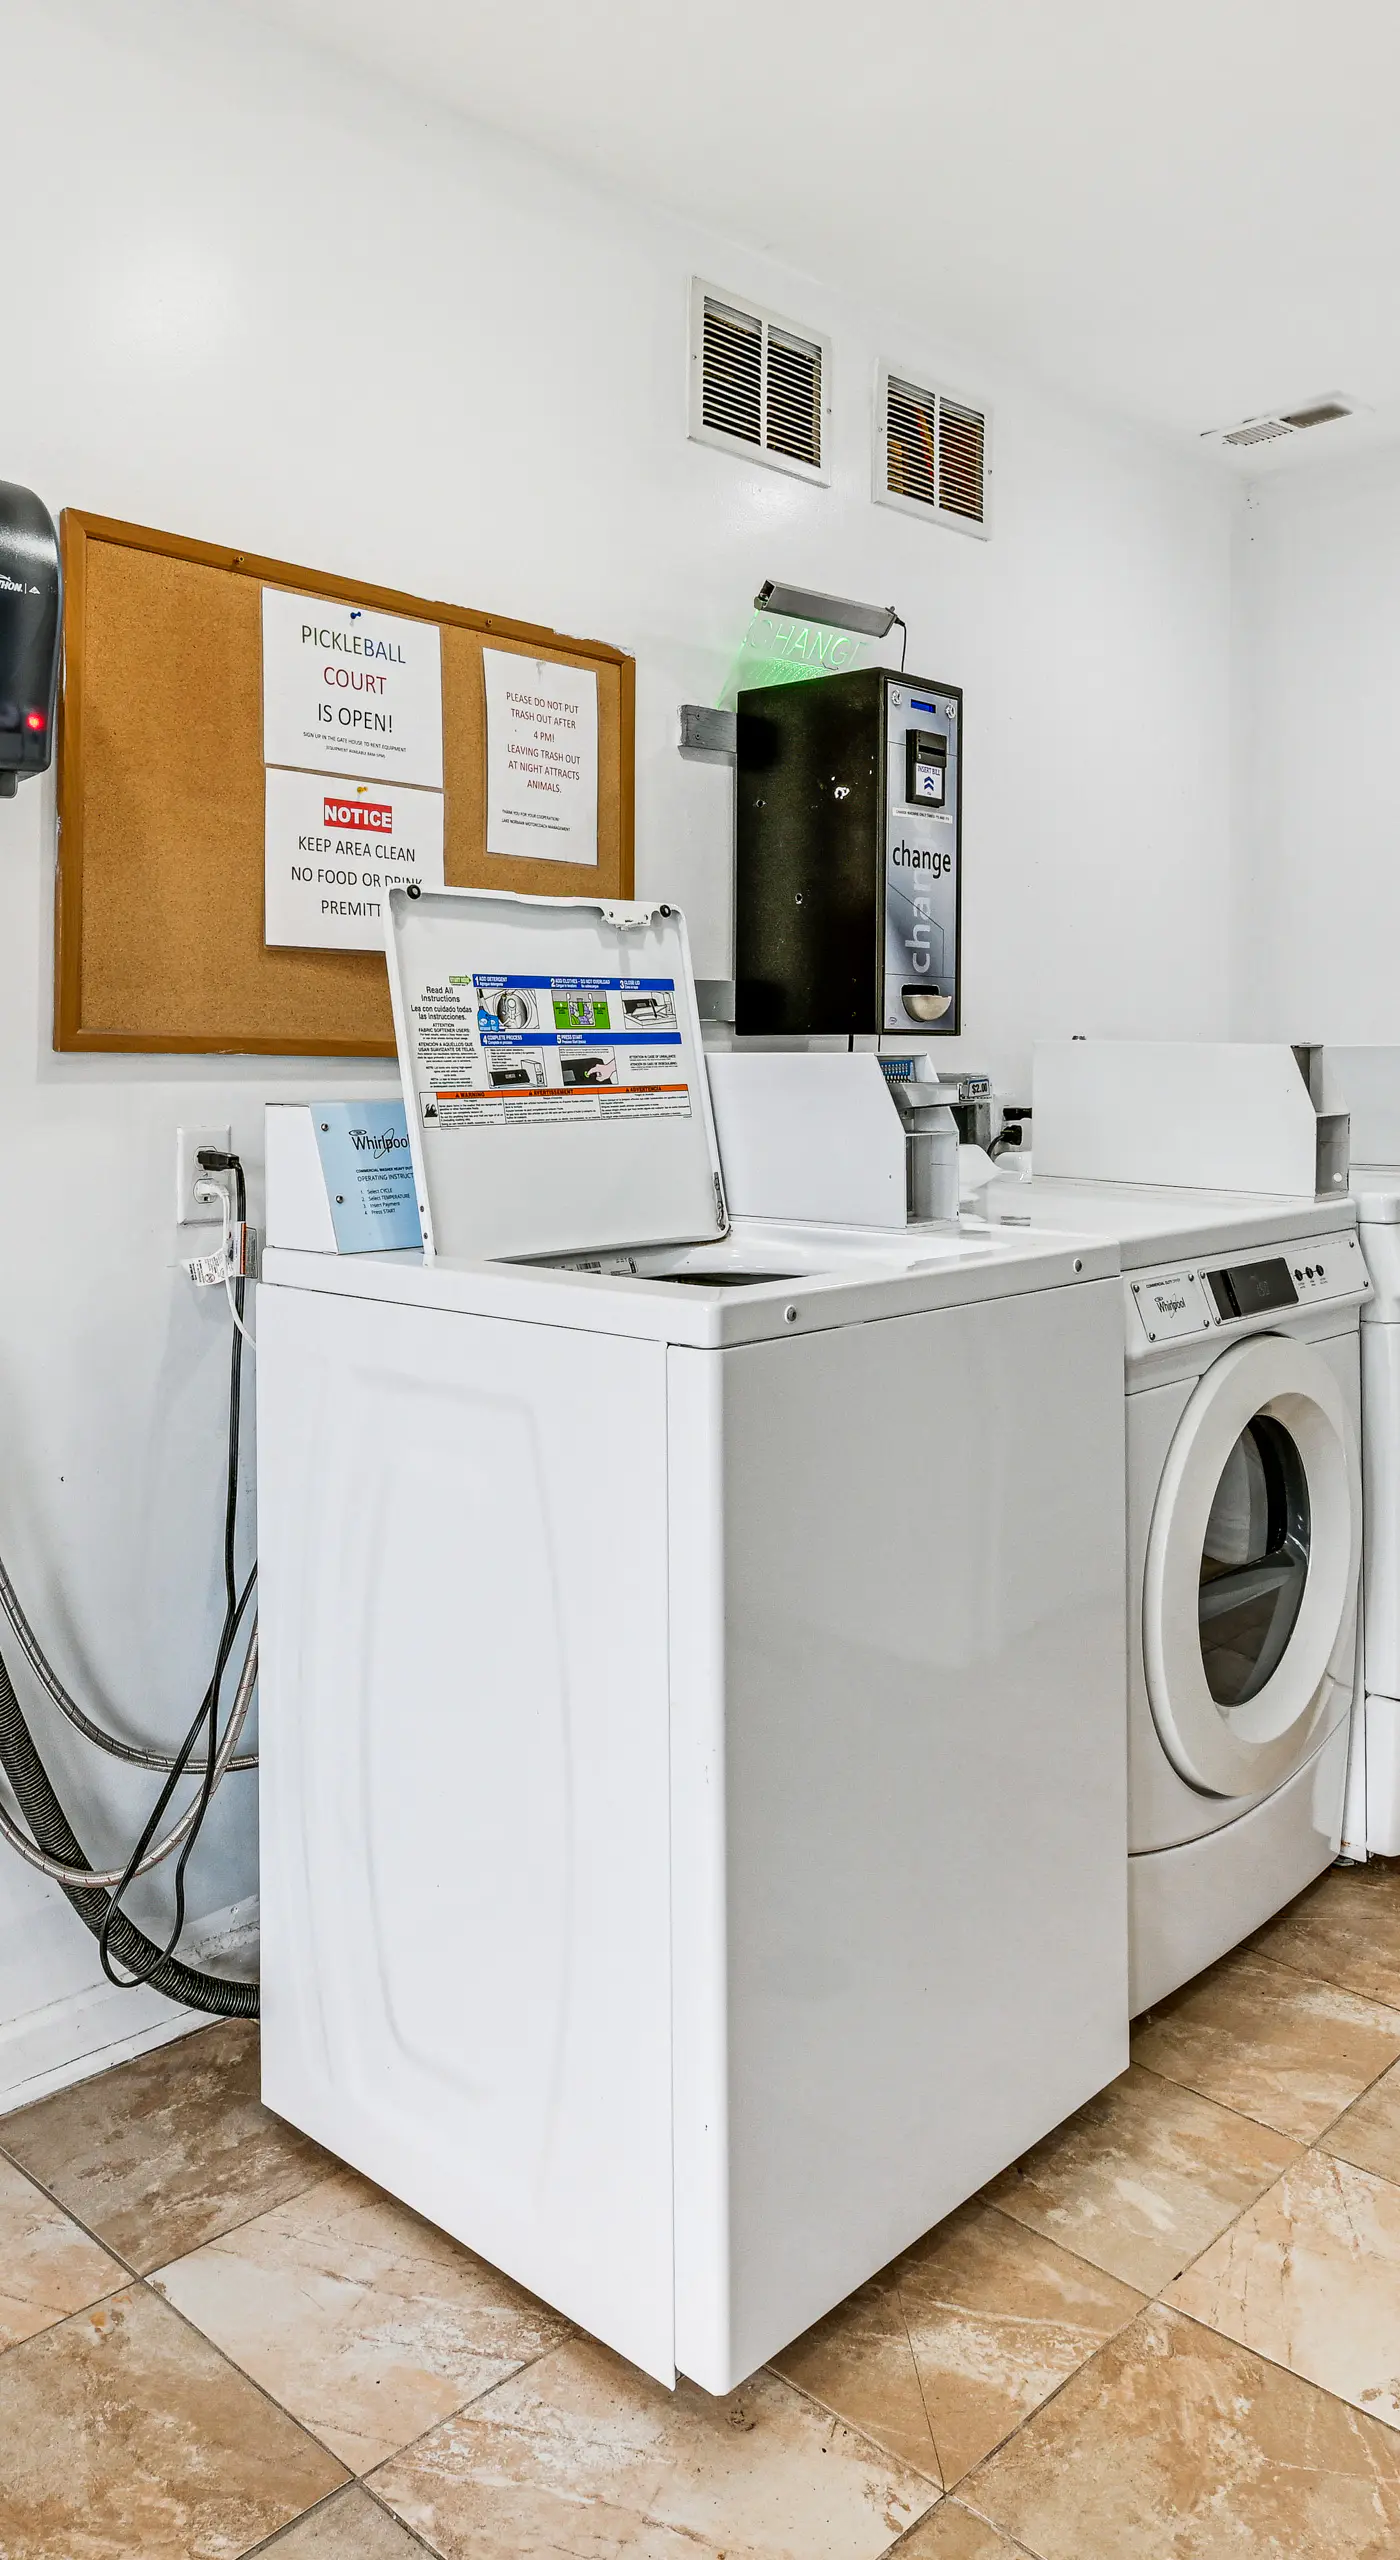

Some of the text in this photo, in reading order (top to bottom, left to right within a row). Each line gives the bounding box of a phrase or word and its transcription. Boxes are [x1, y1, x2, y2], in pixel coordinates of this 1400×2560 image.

[302, 625, 406, 664] PICKLEBALL
[324, 666, 387, 695] COURT
[506, 691, 579, 714] PLEASE DO NOT PUT
[318, 703, 392, 733] IS OPEN!
[511, 708, 576, 729] TRASH OUT AFTER
[533, 731, 555, 742] 4 PM!
[381, 744, 406, 752] EQUIPMENT
[507, 744, 580, 765] LEAVING TRASH OUT
[508, 760, 580, 781] AT NIGHT ATTRACTS
[917, 765, 941, 776] INSERT BILL
[527, 779, 562, 793] ANIMALS.
[324, 804, 392, 828] NOTICE
[298, 836, 415, 862] KEEP AREA CLEAN
[892, 839, 951, 879] change
[291, 866, 313, 882] NO
[317, 869, 357, 885] FOOD
[362, 872, 381, 887] OR
[321, 900, 381, 917] PREMITT
[475, 976, 480, 986] 1
[551, 978, 556, 987] 2
[620, 979, 625, 989] 3
[426, 986, 454, 994] Read All
[421, 994, 460, 1003] Instructions
[411, 1004, 421, 1012] Lea
[483, 1035, 487, 1045] 4
[557, 1034, 562, 1044] 5
[971, 1083, 988, 1095] $2.00
[351, 1133, 410, 1153] Whirlpool
[388, 1172, 413, 1180] INSTRUCT
[1156, 1297, 1186, 1313] Whirlpool
